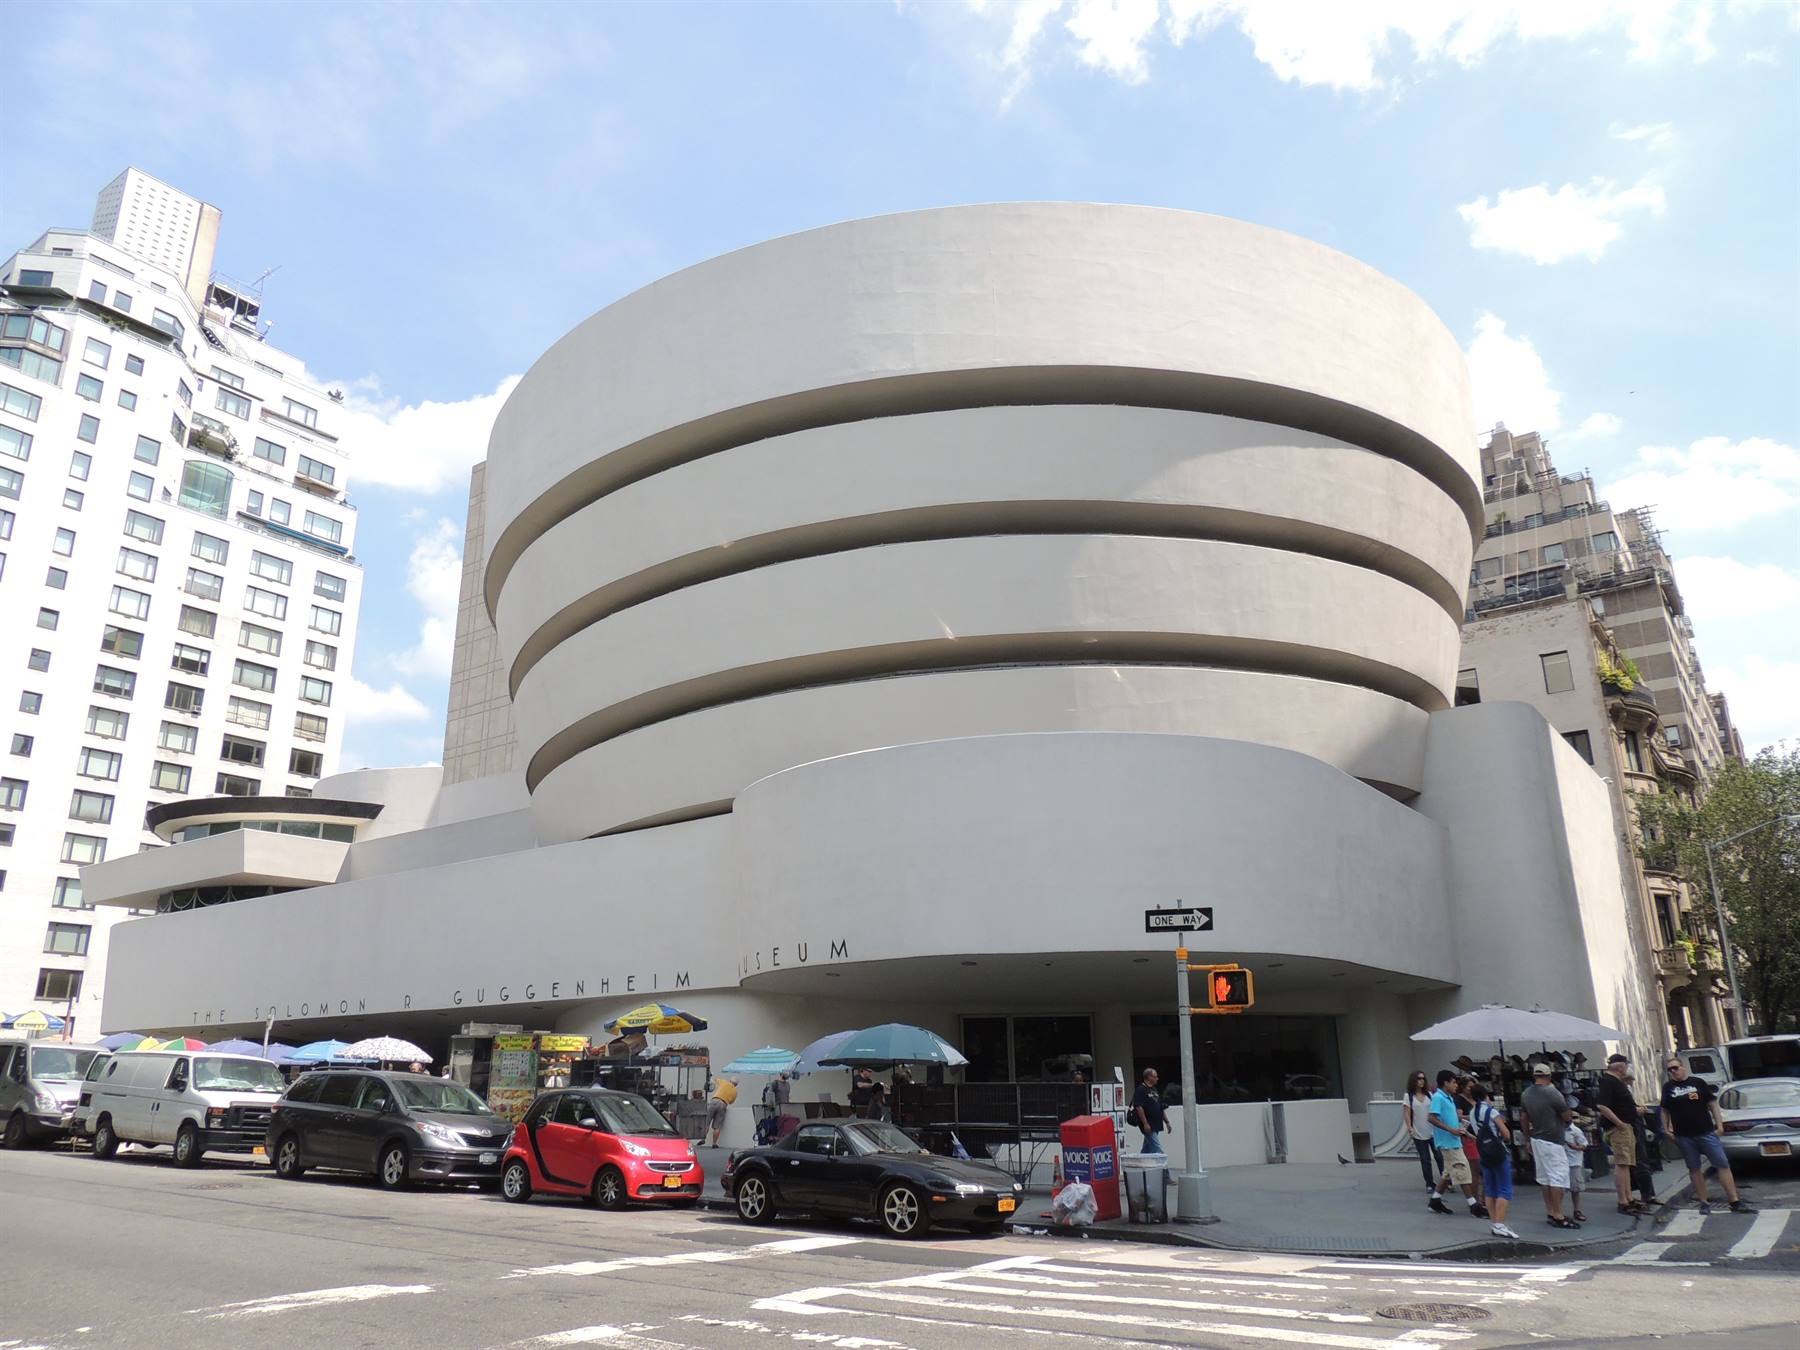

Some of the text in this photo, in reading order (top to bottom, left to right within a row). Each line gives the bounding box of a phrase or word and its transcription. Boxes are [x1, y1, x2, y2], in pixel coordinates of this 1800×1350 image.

[1154, 914, 1203, 926] ONE WAY
[193, 938, 849, 1025] THE SOLOMON R GUGGENHEIM USEUM
[1064, 1151, 1090, 1165] VOICE
[1093, 1150, 1113, 1164] VOICE
